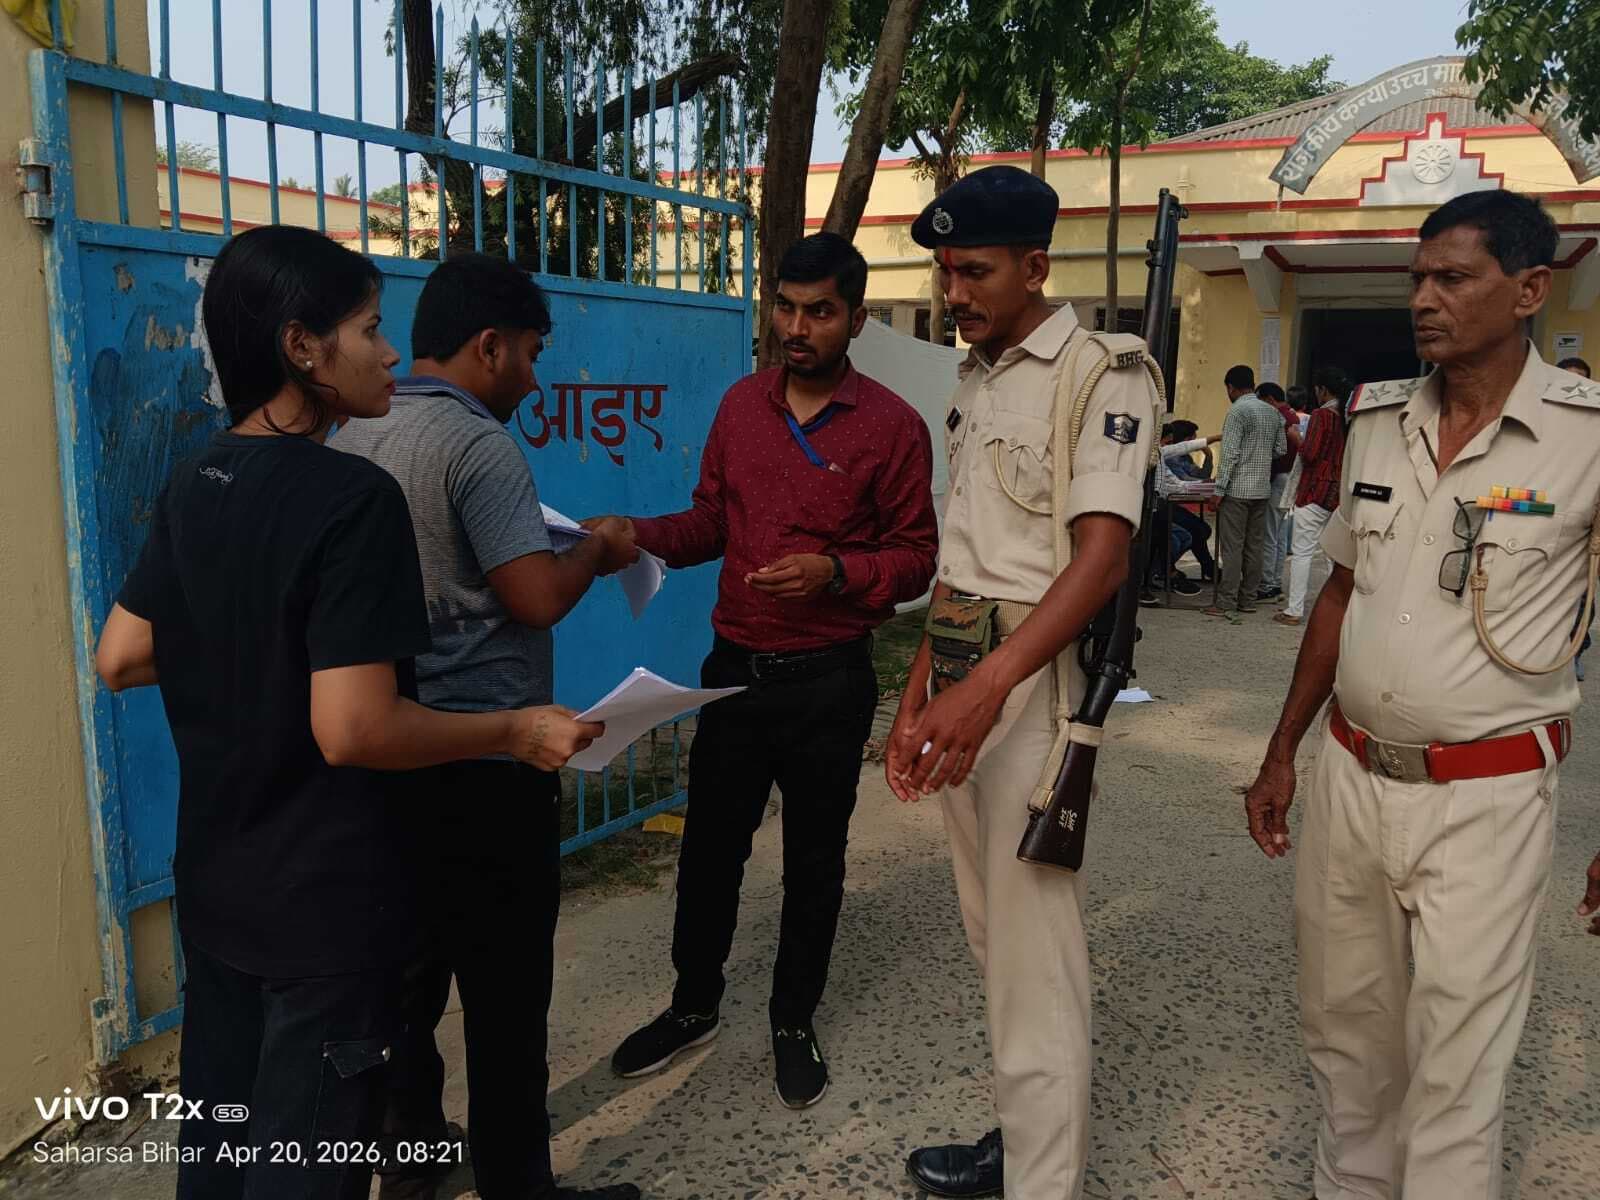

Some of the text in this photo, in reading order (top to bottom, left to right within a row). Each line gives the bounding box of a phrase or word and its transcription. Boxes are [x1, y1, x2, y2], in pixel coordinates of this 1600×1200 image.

[1278, 113, 1343, 181] राजकीय
[1336, 82, 1389, 122] कन्या
[1386, 65, 1430, 96] उच्च
[515, 383, 668, 467] आइए
